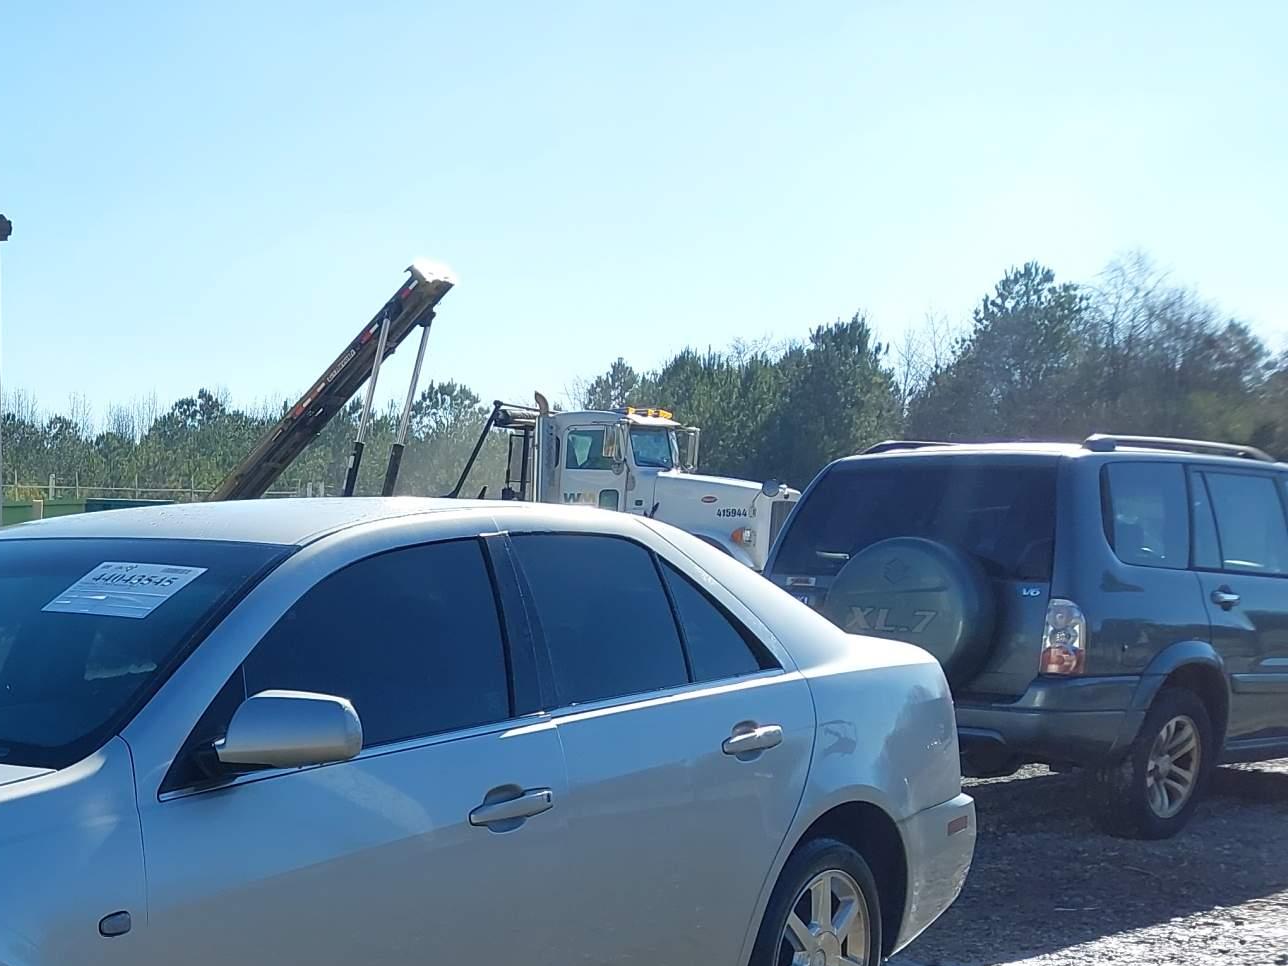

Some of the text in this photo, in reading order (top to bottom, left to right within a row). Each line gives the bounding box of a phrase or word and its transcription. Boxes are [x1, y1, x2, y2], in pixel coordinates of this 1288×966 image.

[716, 508, 747, 518] 415944
[92, 573, 178, 587] 44043545
[1022, 588, 1040, 596] V6
